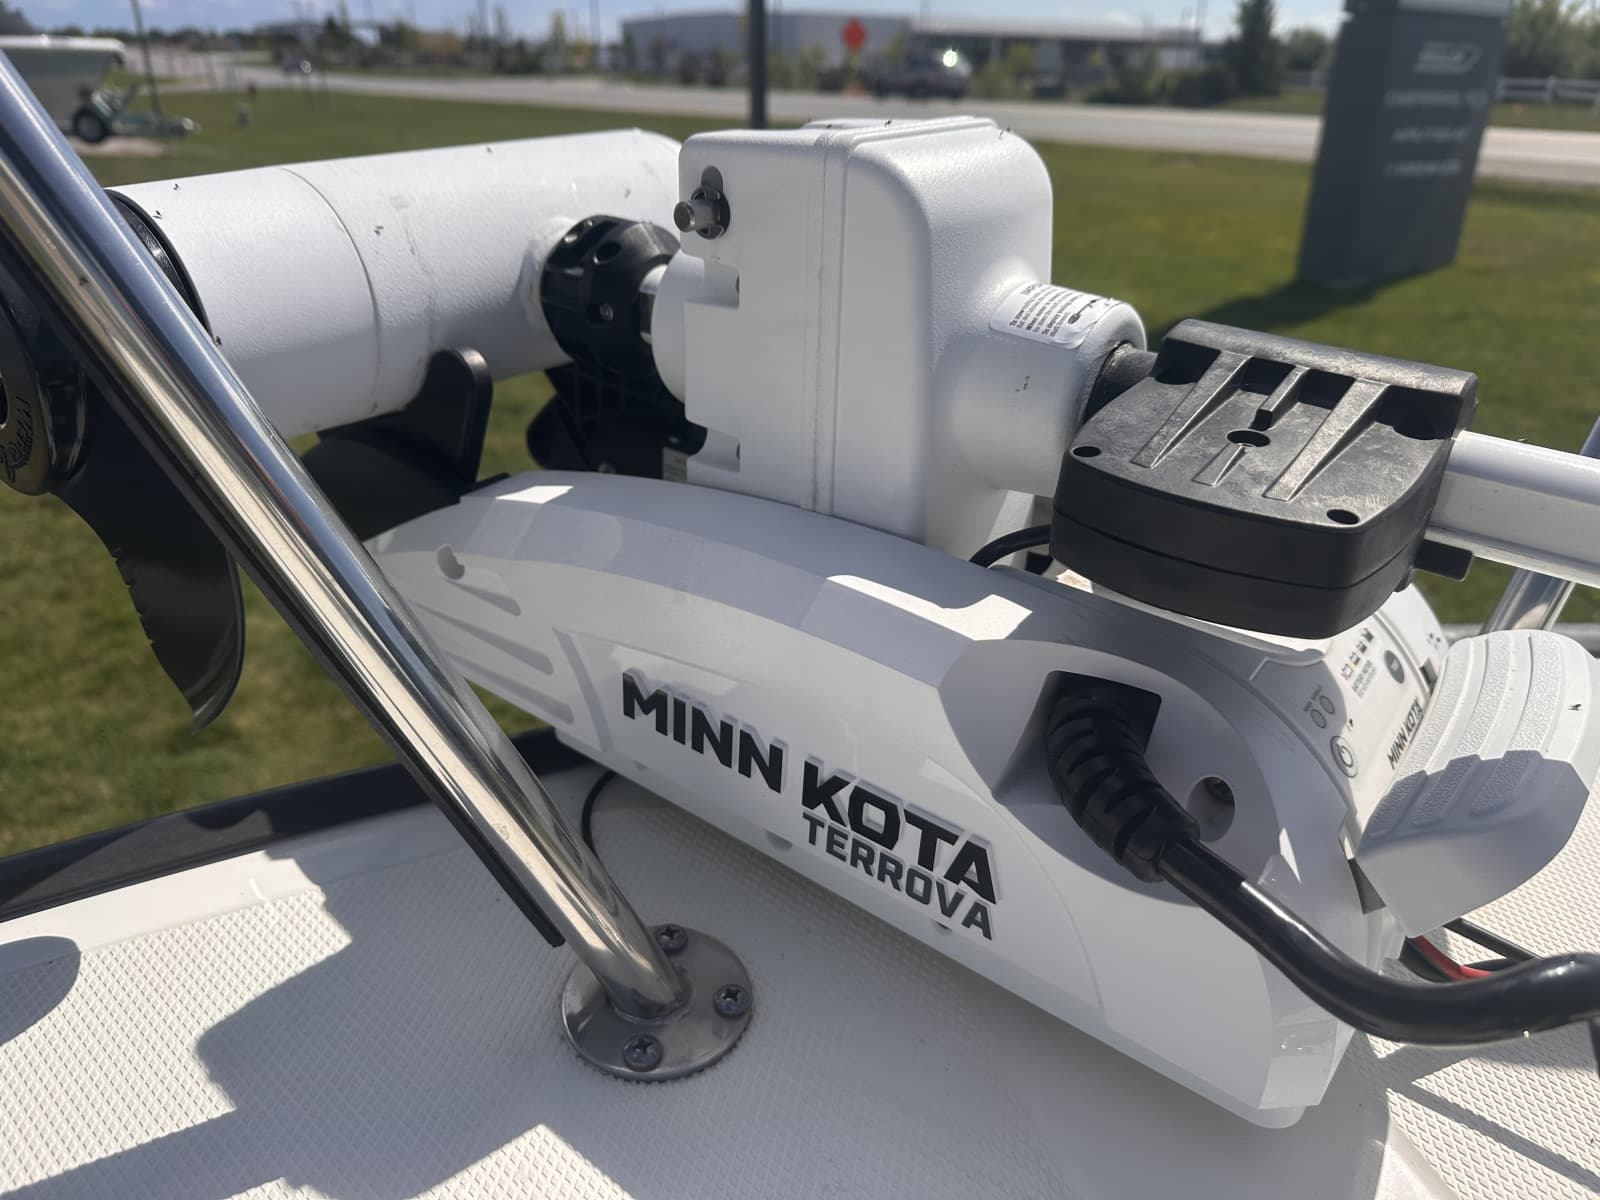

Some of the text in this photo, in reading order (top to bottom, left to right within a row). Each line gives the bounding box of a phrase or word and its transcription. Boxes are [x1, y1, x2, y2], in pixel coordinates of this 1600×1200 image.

[622, 670, 997, 906] MINN KOTA
[1387, 727, 1408, 770] MINN
[802, 811, 993, 942] TERROVA
